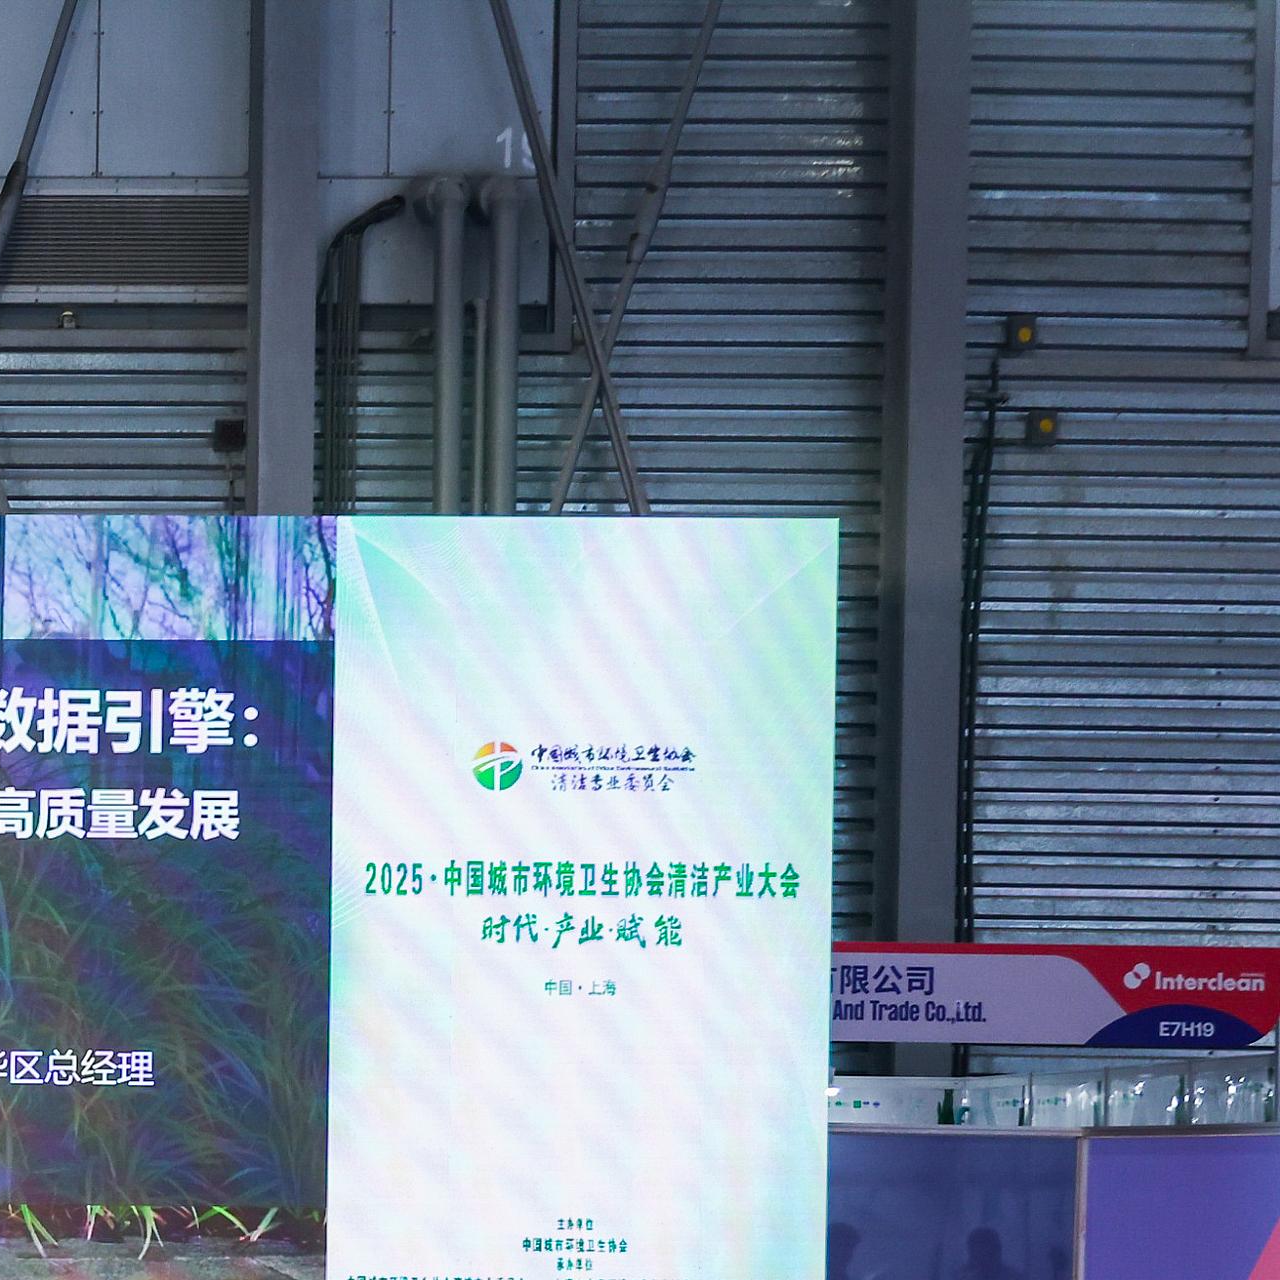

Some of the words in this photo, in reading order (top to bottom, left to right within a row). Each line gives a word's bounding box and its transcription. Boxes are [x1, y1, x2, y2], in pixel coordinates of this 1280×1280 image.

[544, 979, 616, 997] 中国·上海
[1154, 971, 1266, 991] Interclean
[833, 1000, 865, 1021] And
[870, 1000, 920, 1022] Trade
[1159, 1021, 1215, 1037] E7H19
